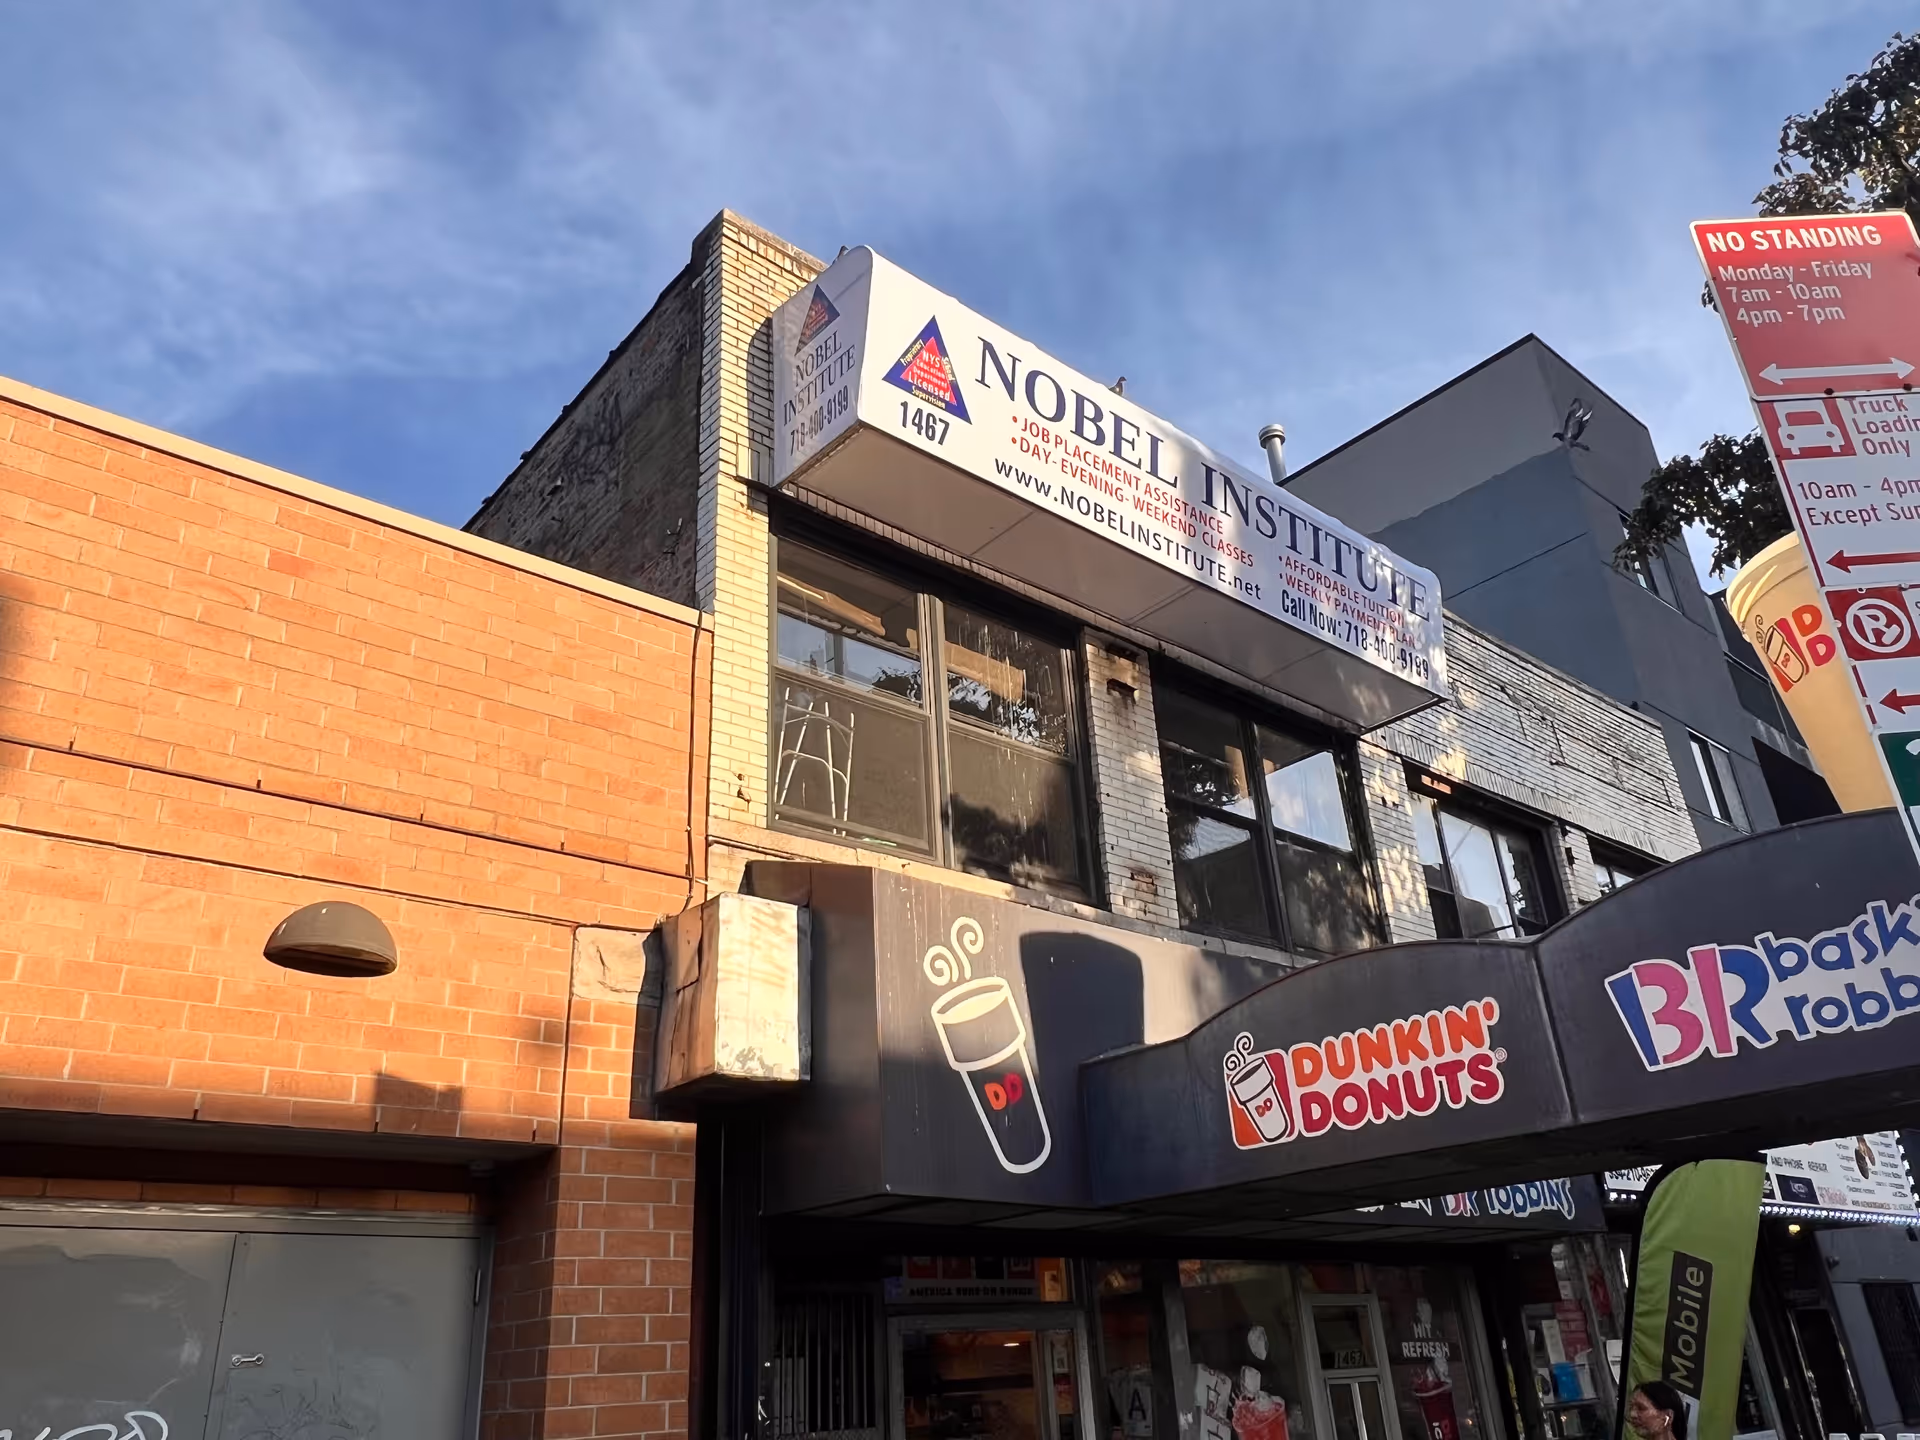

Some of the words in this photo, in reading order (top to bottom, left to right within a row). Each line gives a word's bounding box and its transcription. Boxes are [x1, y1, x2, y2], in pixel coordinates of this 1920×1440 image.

[1705, 231, 1746, 252] NO
[1750, 225, 1882, 250] STANDING
[1718, 263, 1794, 282] Monday
[1811, 260, 1872, 279] Friday
[1726, 286, 1771, 303] 7am
[1787, 283, 1842, 300] 10am
[1737, 307, 1783, 327] 4pm
[1797, 305, 1846, 324] 7pm
[795, 330, 842, 386] NOBEL
[923, 350, 941, 368] NYS
[783, 344, 856, 426] INSTITUTE
[908, 371, 951, 402] Licensed
[1844, 395, 1909, 414] Truck
[900, 401, 950, 446] 1467
[1862, 437, 1911, 457] Only
[975, 336, 1178, 488] NOBEL
[1201, 461, 1430, 622] INSTITUTE
[1021, 418, 1050, 443] JOB
[1055, 434, 1141, 491] PLACEMENT
[1144, 483, 1224, 535] ASSISTANCE
[1797, 481, 1857, 500] 10am
[1805, 504, 1882, 527] Except
[1202, 531, 1254, 567] CLASSES
[1285, 556, 1359, 605] AFFORDABLE
[1362, 594, 1405, 628] TUITION
[1286, 574, 1331, 606] WEEKLY
[1334, 599, 1386, 635] PAYMENT
[1389, 626, 1416, 650] PLAN
[1281, 589, 1307, 622] Call
[1344, 619, 1429, 680] 718-400-9199
[1758, 904, 1920, 983] bask
[1607, 947, 1770, 1067] BR
[1291, 1001, 1495, 1087] DUNKIN'
[1300, 1052, 1500, 1134] DONUTS
[1413, 1322, 1432, 1339] HIT
[1670, 1265, 1704, 1389] Mobile
[1401, 1341, 1450, 1358] REFRESH
[1129, 1388, 1146, 1421] A
